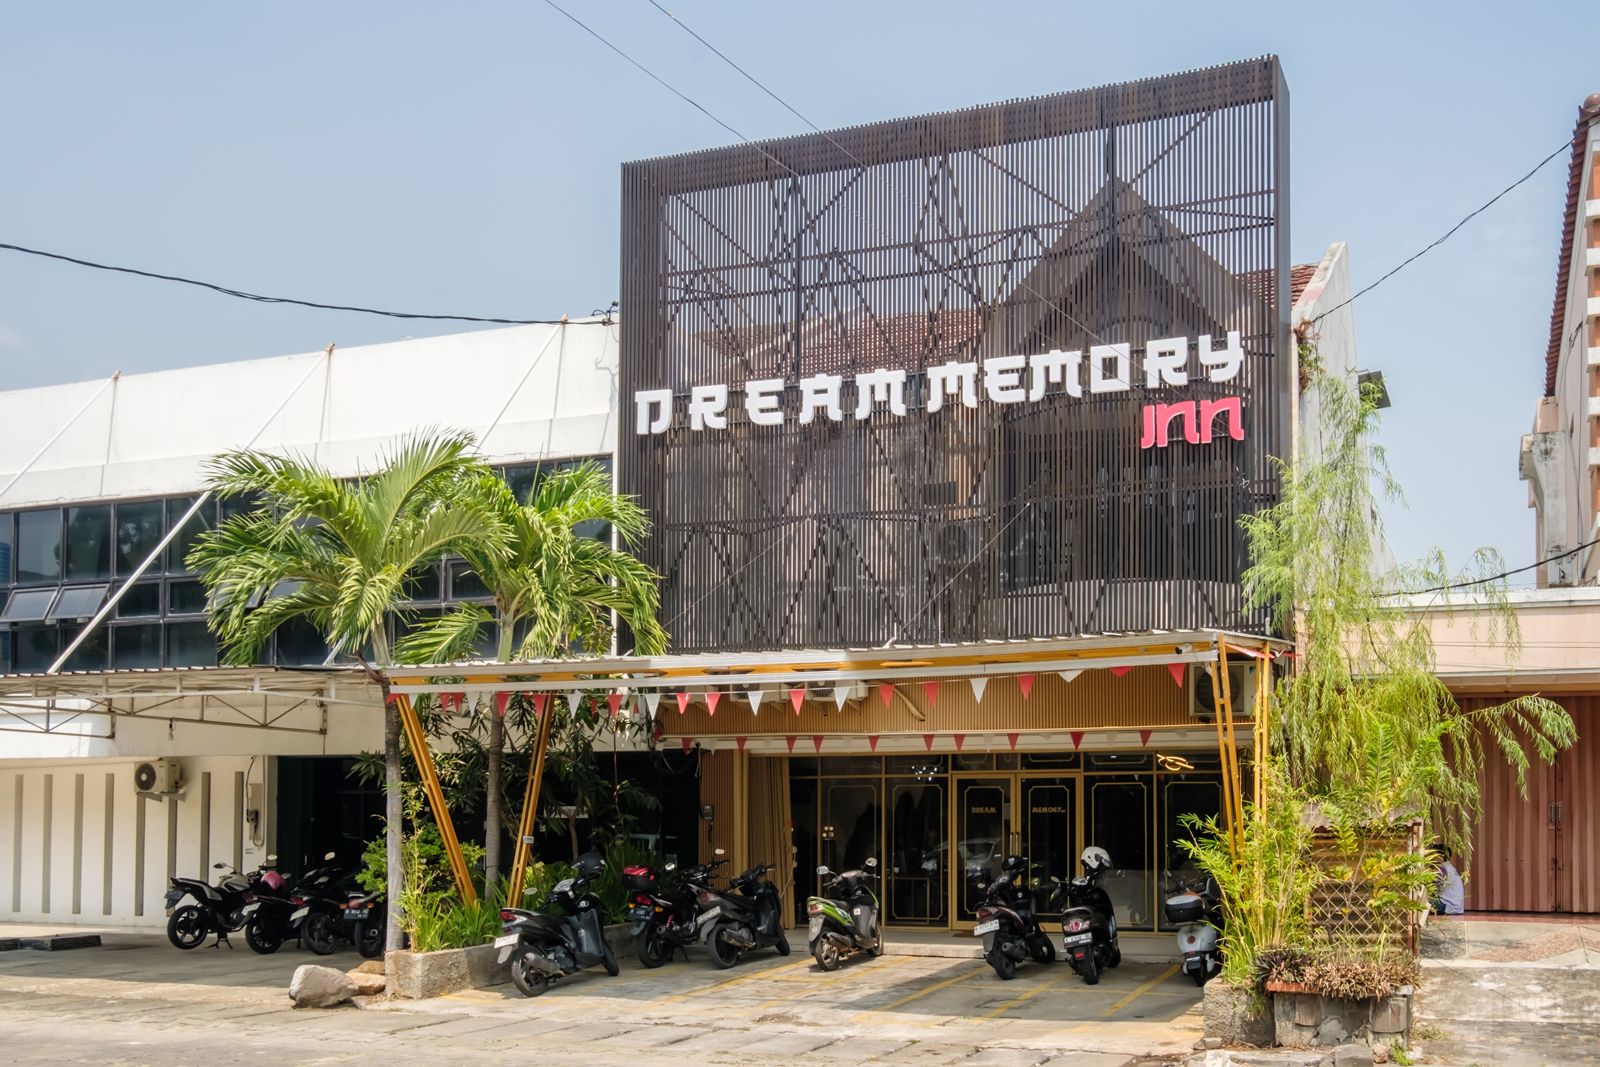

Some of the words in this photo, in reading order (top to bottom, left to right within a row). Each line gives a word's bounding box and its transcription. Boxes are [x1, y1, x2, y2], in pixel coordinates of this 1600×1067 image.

[634, 368, 907, 436] DREAM
[926, 330, 1243, 414] MEMORY
[971, 806, 997, 814] DREAM
